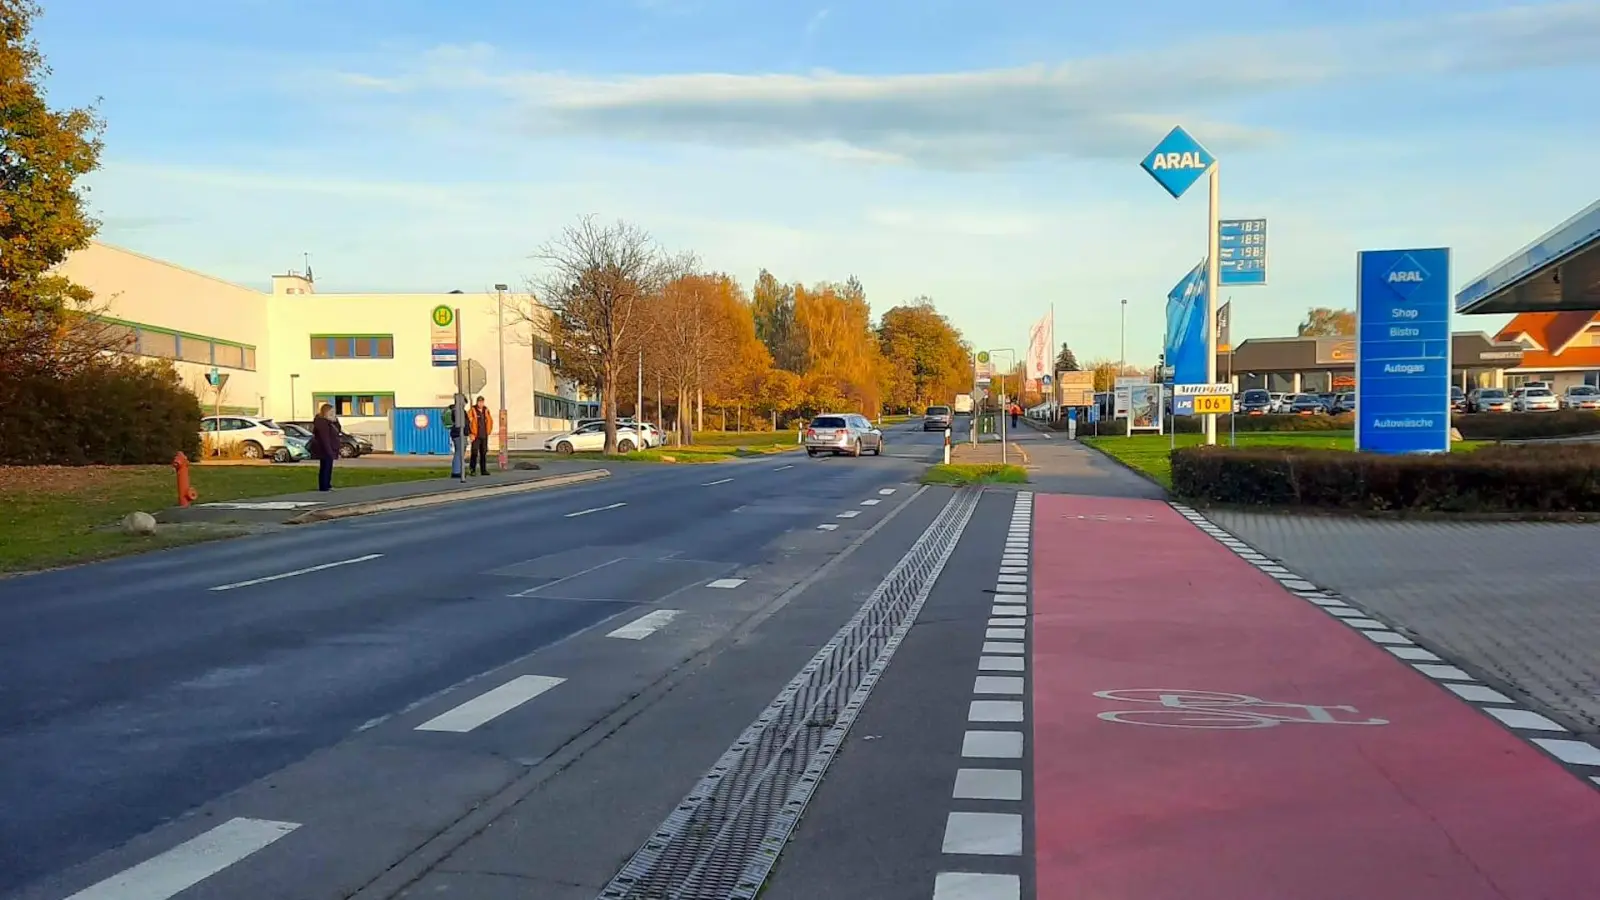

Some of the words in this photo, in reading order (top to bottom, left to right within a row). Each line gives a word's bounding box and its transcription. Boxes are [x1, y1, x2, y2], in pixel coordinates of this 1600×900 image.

[1152, 151, 1206, 170] ARAL
[1388, 270, 1423, 283] ARAL
[1391, 308, 1418, 319] Shop
[1389, 326, 1419, 337] Bistro
[1384, 363, 1425, 374] Autogas
[1177, 400, 1192, 408] LPG
[1373, 418, 1434, 429] Autowäsche
